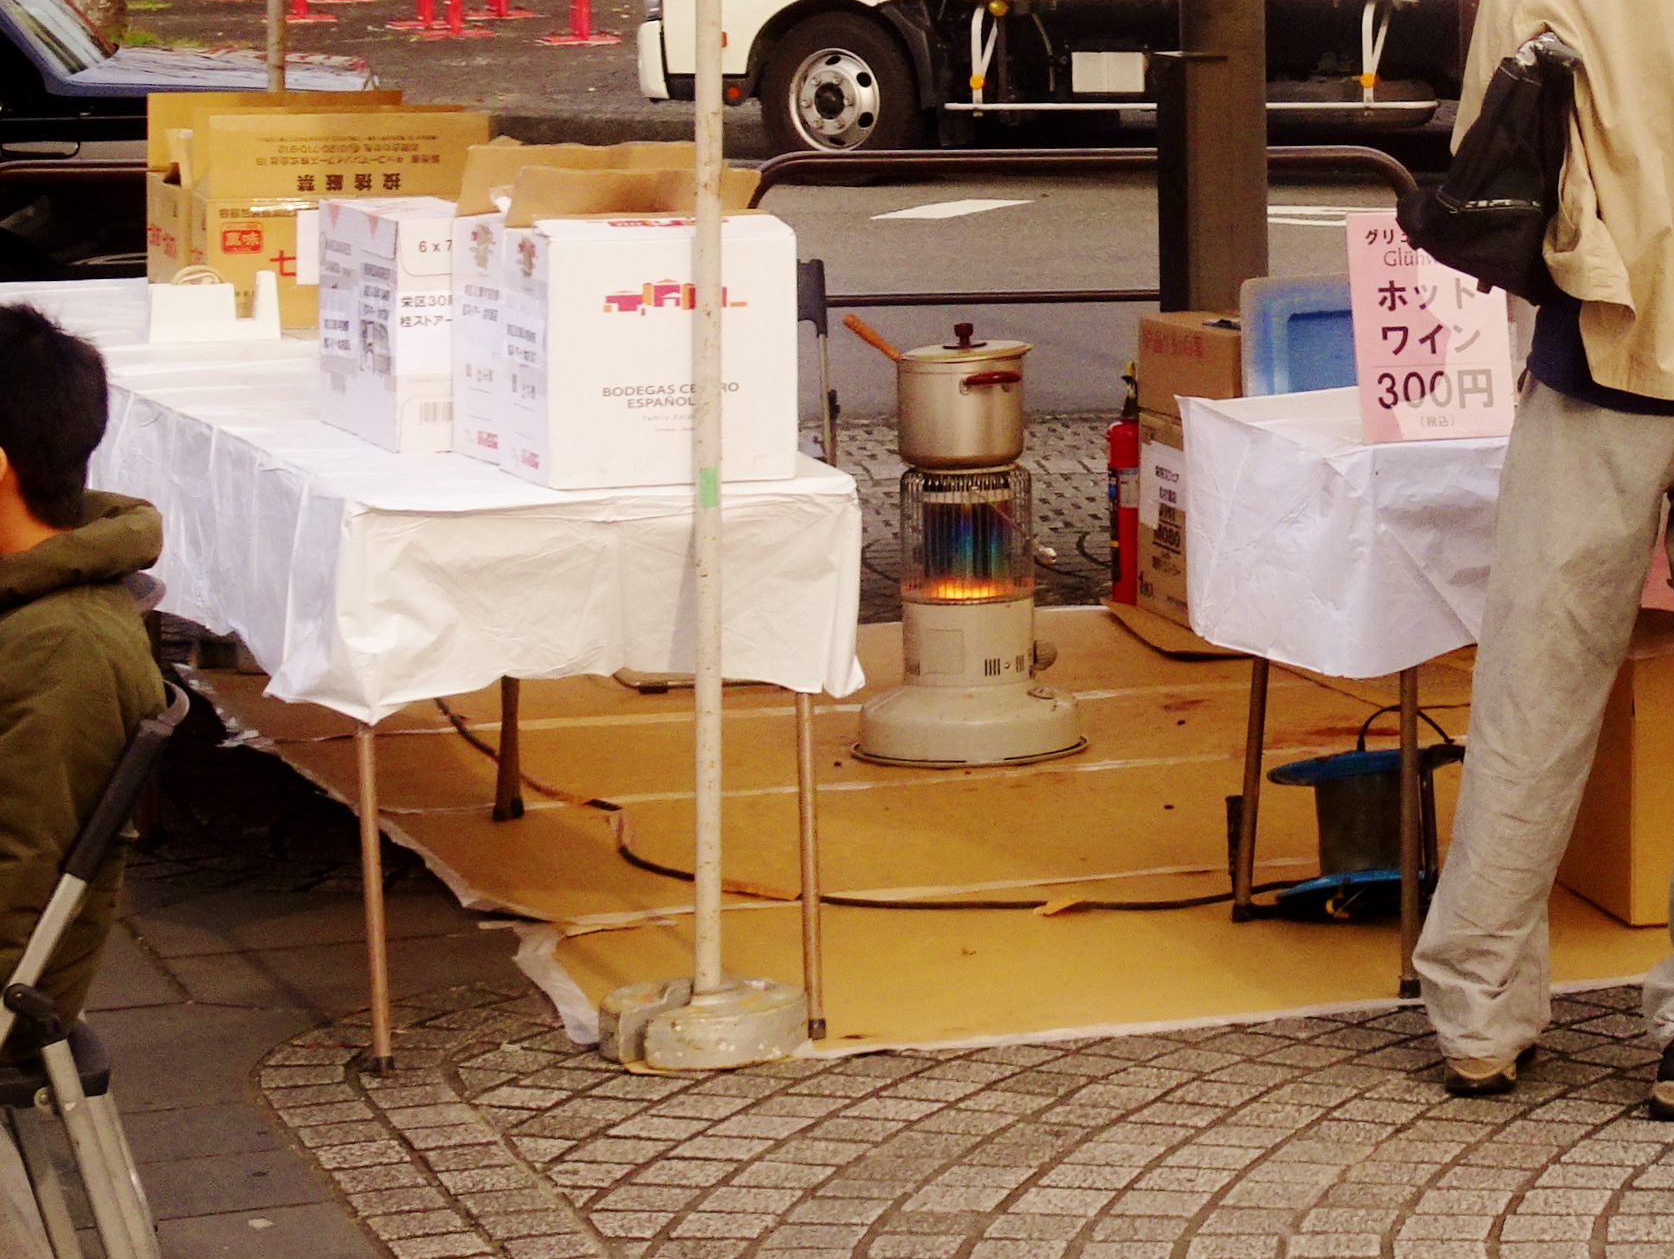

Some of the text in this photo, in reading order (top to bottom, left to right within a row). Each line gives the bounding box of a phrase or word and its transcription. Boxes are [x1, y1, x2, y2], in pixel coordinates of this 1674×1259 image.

[418, 240, 427, 253] 6
[1377, 277, 1476, 312] ホット
[1381, 323, 1482, 356] ワイン
[602, 384, 676, 398] BODEGAS
[1377, 368, 1494, 410] 300円
